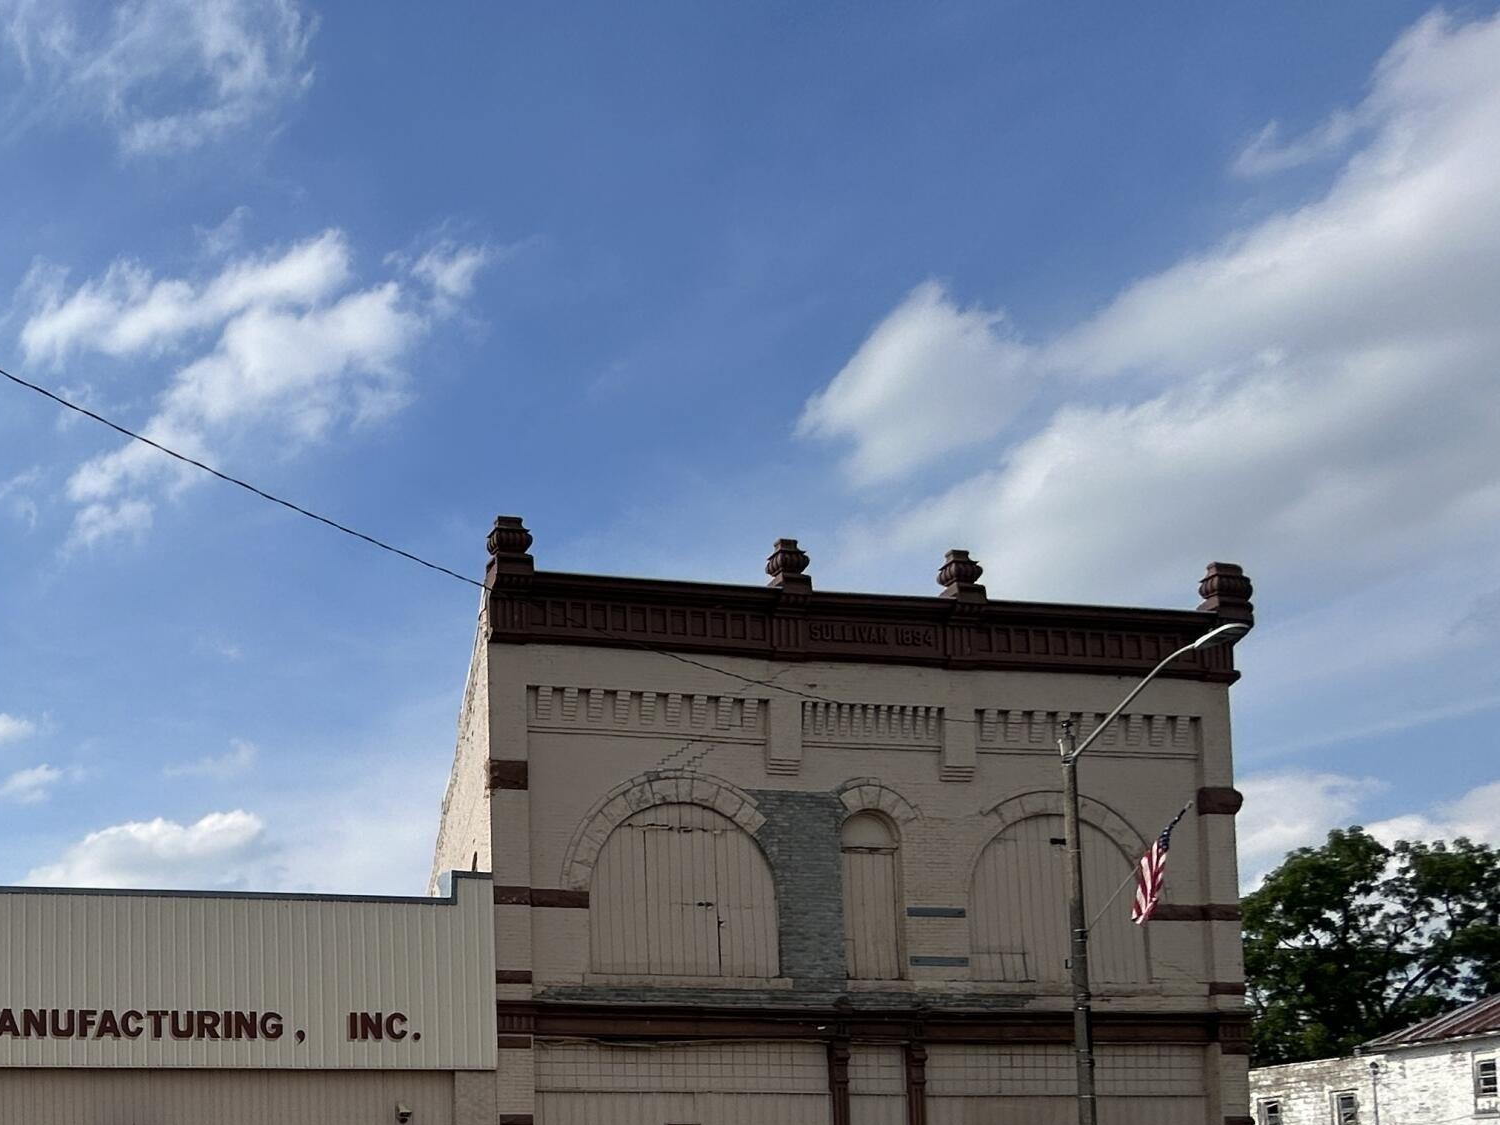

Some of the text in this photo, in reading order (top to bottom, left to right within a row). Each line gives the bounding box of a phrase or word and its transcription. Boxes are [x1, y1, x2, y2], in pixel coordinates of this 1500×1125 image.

[809, 623, 934, 647] SULLIVAN 1894
[347, 1012, 421, 1041] INC.
